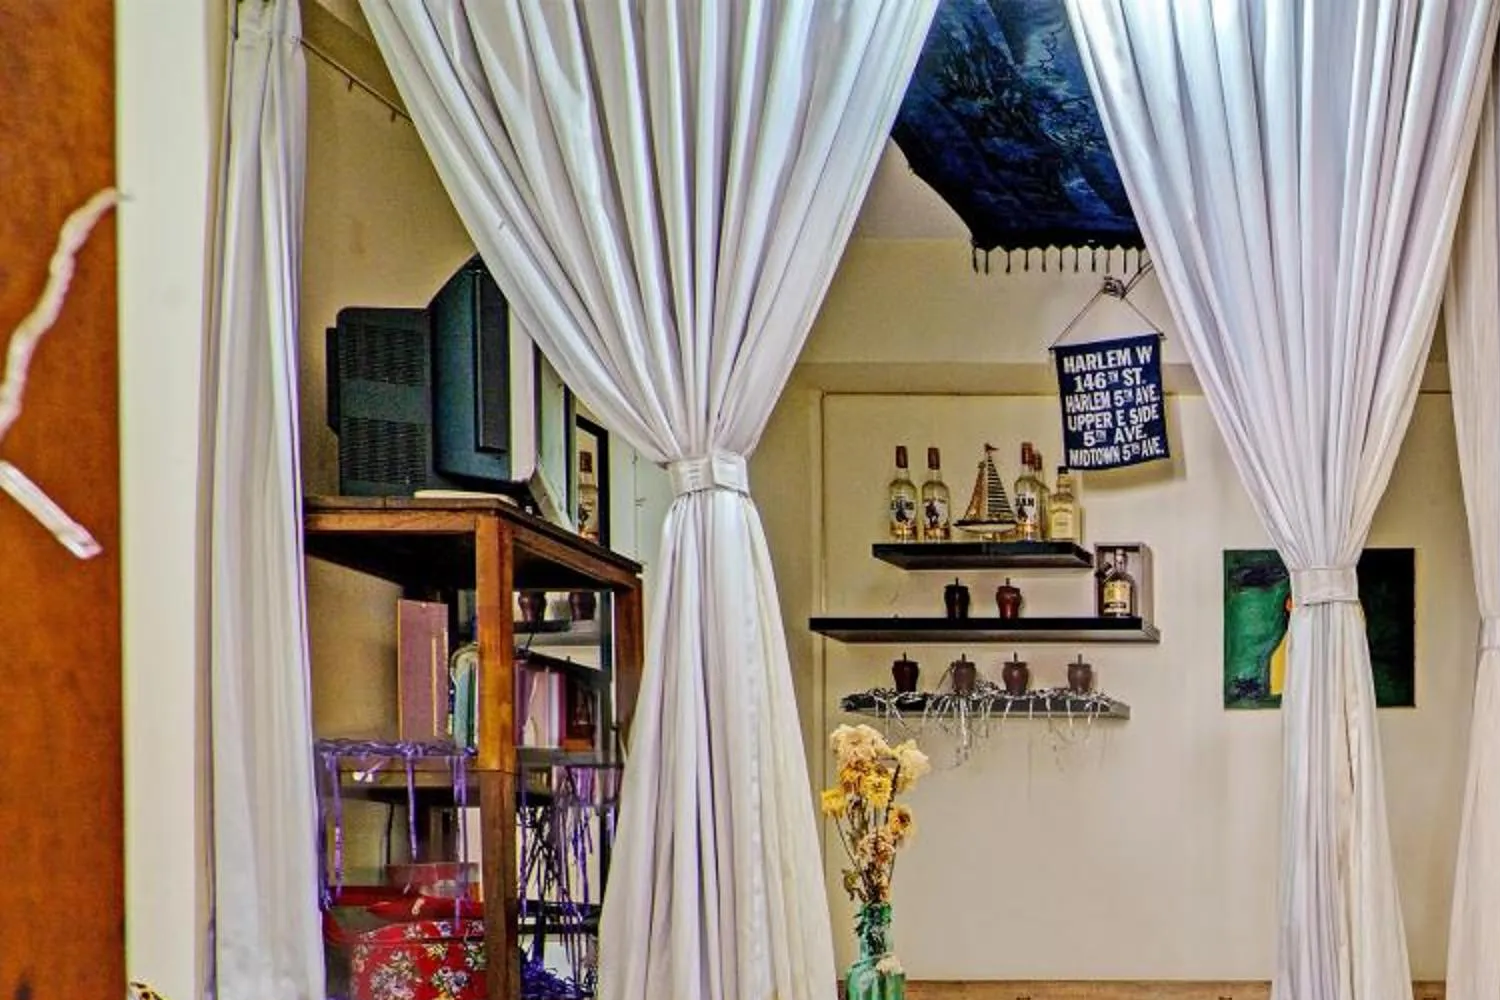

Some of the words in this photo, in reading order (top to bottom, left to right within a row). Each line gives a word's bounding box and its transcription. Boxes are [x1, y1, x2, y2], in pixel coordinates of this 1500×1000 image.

[1063, 348, 1131, 374] HARLEM
[1135, 346, 1153, 364] W
[1074, 370, 1119, 393] 146TH
[1122, 367, 1146, 387] ST.
[1065, 391, 1111, 413] HARLEM
[1114, 389, 1134, 406] 5TH
[1135, 384, 1160, 405] AVE.
[1068, 411, 1113, 432] UPPER
[1116, 410, 1125, 427] E
[1129, 404, 1159, 426] SIDE
[1083, 429, 1107, 447] 5TH
[1114, 425, 1147, 445] AVE.
[1069, 446, 1121, 467] MIDTOWN
[1122, 444, 1140, 461] 5TH
[1141, 437, 1164, 457] AVE.
